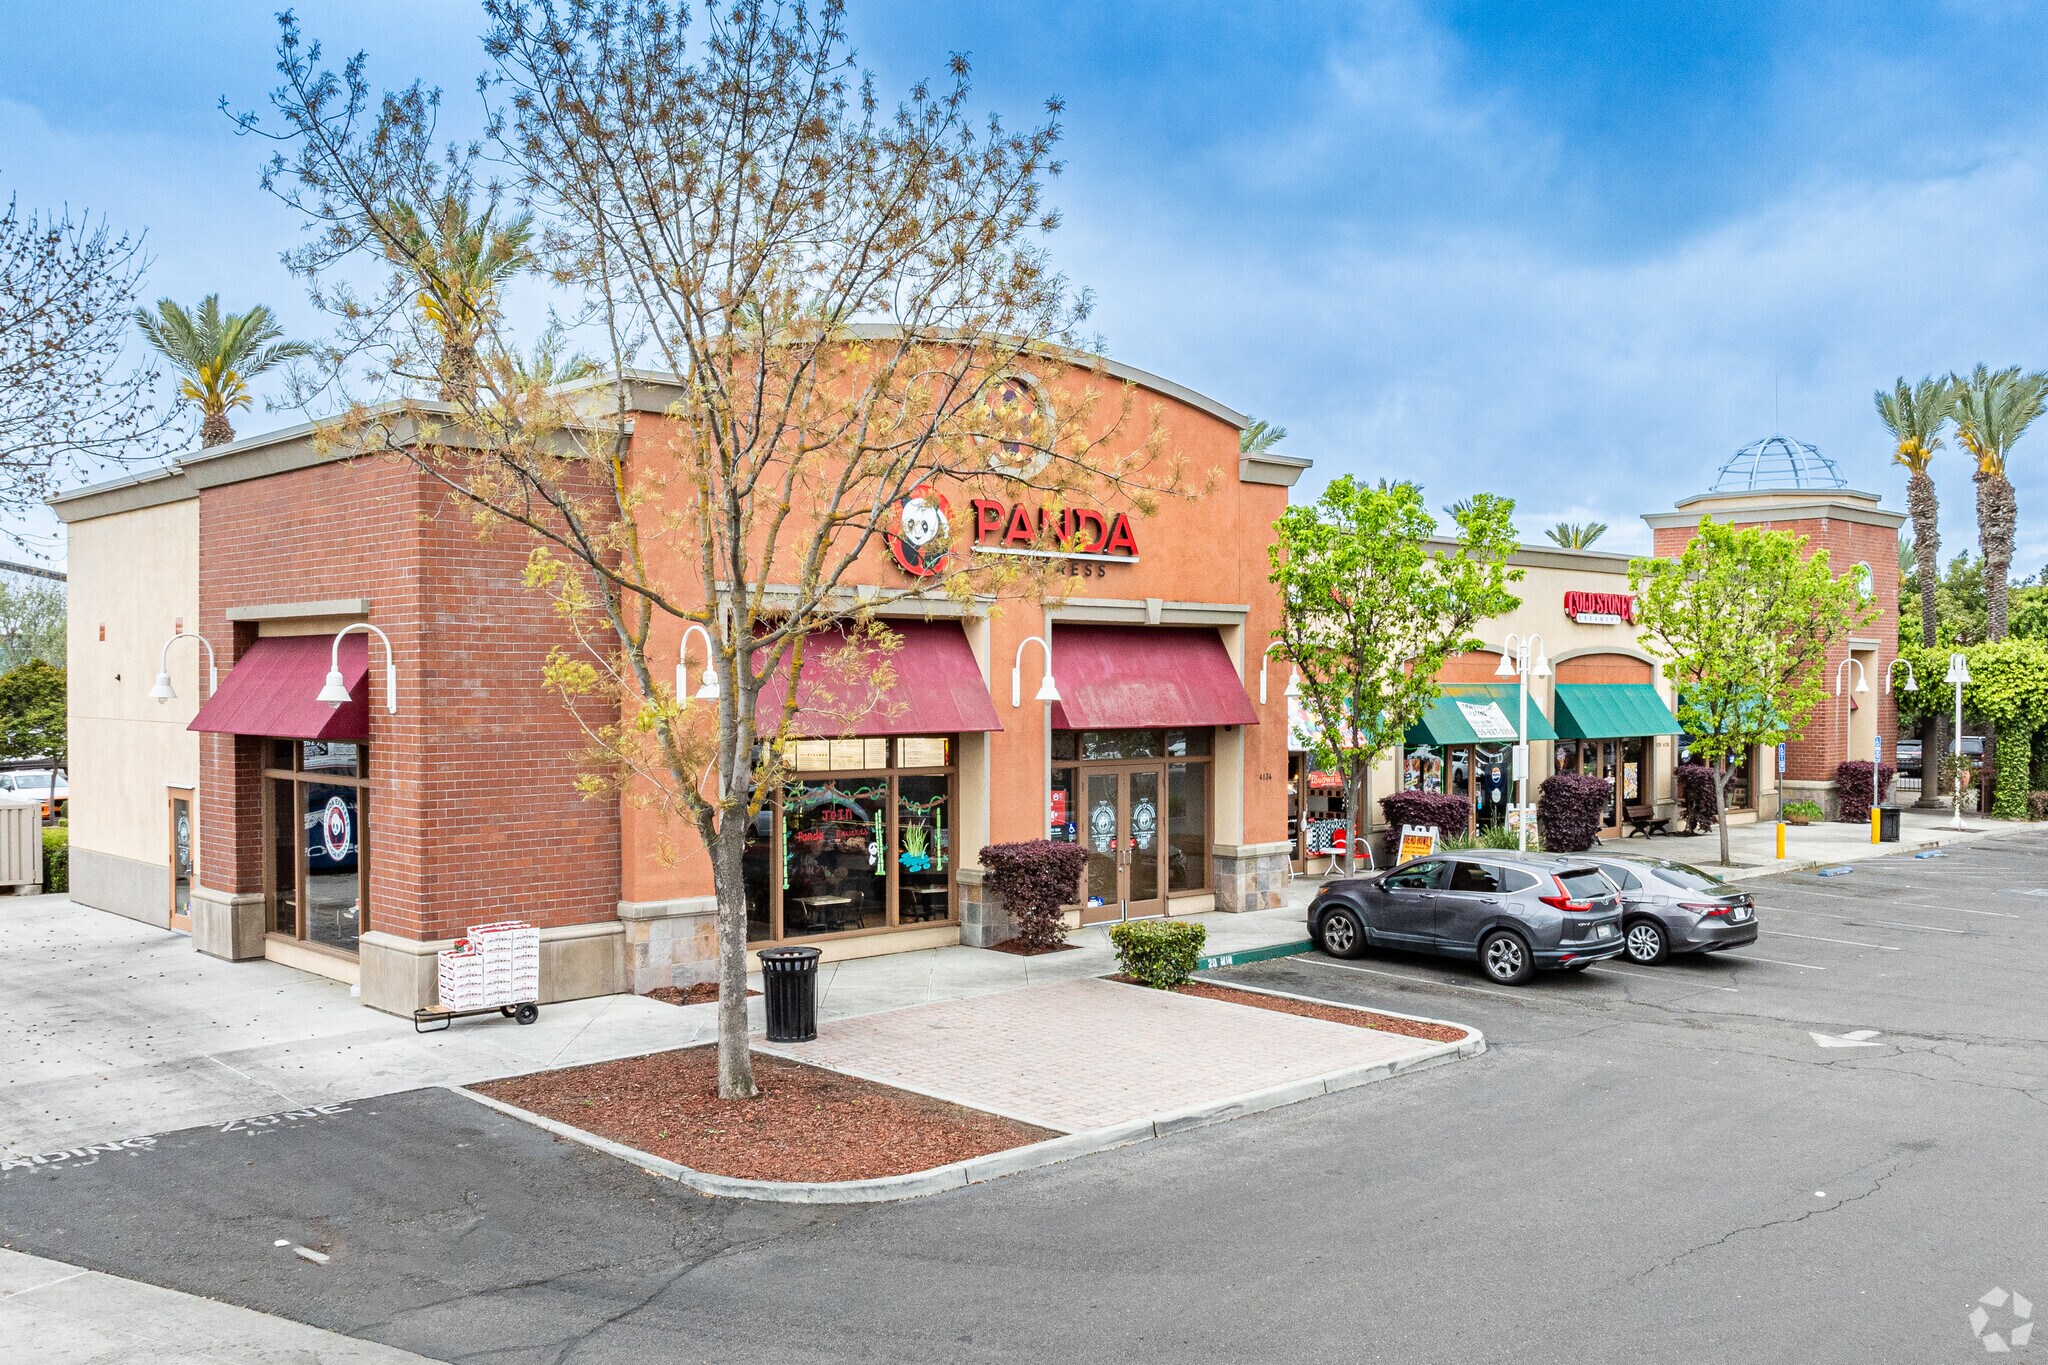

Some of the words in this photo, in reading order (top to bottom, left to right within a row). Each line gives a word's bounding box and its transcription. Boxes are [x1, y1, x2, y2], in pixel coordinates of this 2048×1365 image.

[971, 498, 1139, 556] PANDA
[1568, 591, 1595, 617] COLD
[1596, 593, 1629, 619] STONE
[822, 808, 853, 821] JOIN
[797, 828, 825, 843] Panda
[1207, 957, 1218, 969] 20
